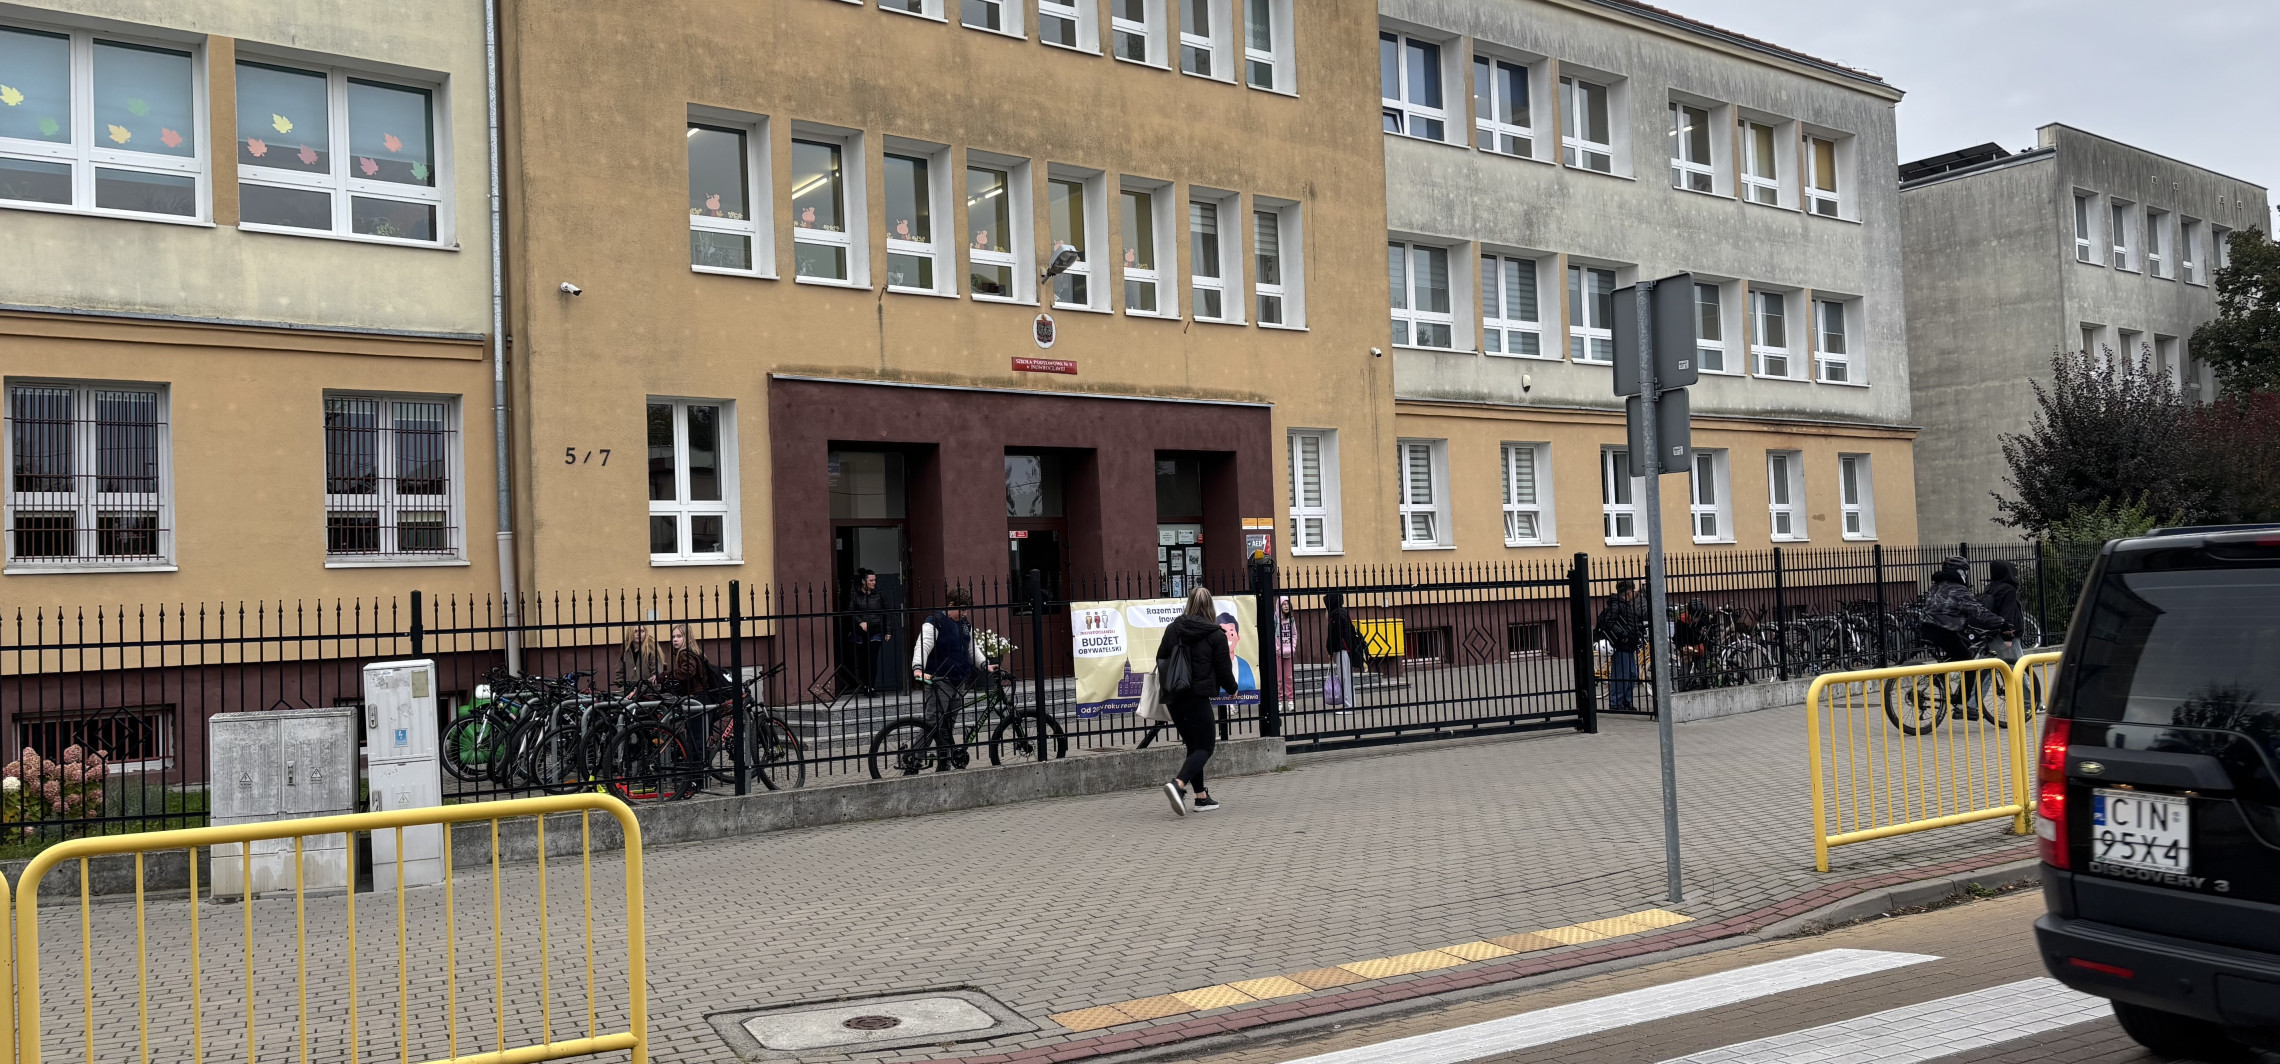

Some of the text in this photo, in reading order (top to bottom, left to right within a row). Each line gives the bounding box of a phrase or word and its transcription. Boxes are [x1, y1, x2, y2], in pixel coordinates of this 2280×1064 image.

[1146, 606, 1185, 615] Razem zmi
[1158, 615, 1177, 623] Inow
[1081, 635, 1119, 647] BUDŻET
[1078, 646, 1122, 655] OBYWATELSKI
[2093, 812, 2106, 821] PL
[2112, 798, 2168, 832] CIN
[2101, 830, 2180, 867] 95X4
[2089, 860, 2207, 889] DISCOVERY
[2213, 879, 2231, 893] 3
